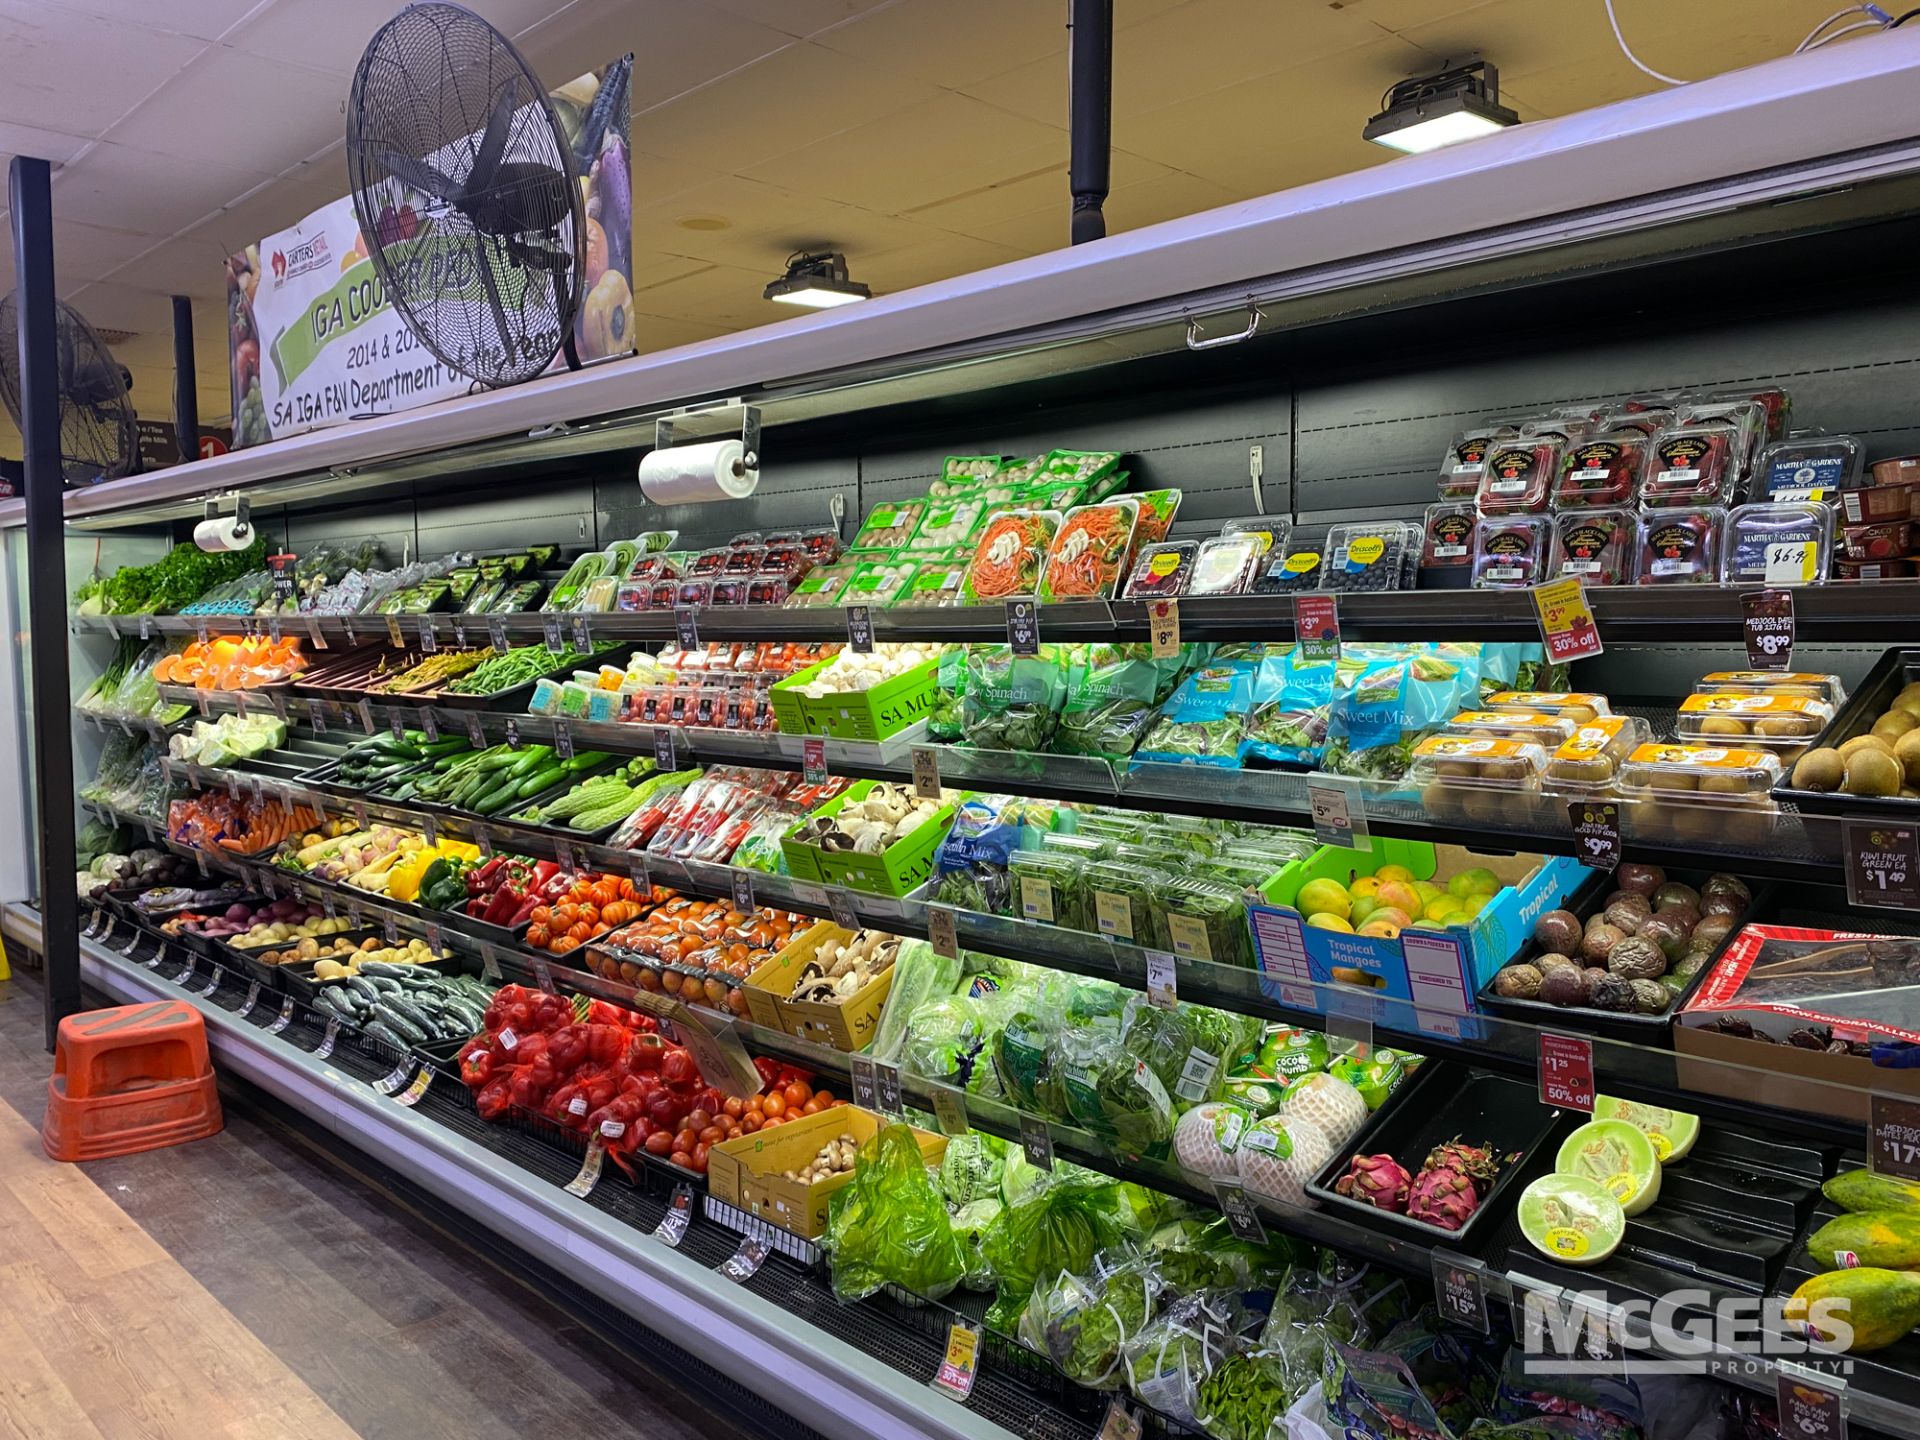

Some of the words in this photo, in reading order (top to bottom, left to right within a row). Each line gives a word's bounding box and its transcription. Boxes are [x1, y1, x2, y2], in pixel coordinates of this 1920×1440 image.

[288, 245, 314, 267] CARTERS
[311, 297, 344, 343] IGA
[347, 339, 378, 370] 2014
[382, 334, 391, 359] &
[272, 402, 293, 428] SA
[297, 393, 324, 423] IGA
[325, 381, 347, 416] F&V
[350, 362, 442, 413] Department
[201, 441, 215, 459] 1
[1811, 458, 1842, 467] GARDENS
[1780, 532, 1811, 542] GARDENS
[1351, 544, 1381, 553] Driscoll's
[1746, 617, 1776, 626] MEDJOOL
[1305, 645, 1324, 655] 30%
[1325, 644, 1338, 655] off
[1554, 637, 1578, 652] 30%
[1580, 632, 1594, 646] off
[986, 687, 1027, 700] Spinach
[1084, 682, 1124, 697] Spinach
[881, 706, 904, 728] SA
[1337, 708, 1379, 724] Sweet
[1383, 709, 1415, 726] Mix
[969, 844, 993, 859] Mix
[1860, 851, 1880, 860] KIWI
[1882, 852, 1907, 862] FRUIT
[1862, 860, 1892, 869] GREEN
[1894, 862, 1907, 871] EA
[900, 865, 921, 889] SA
[1518, 876, 1559, 925] Tropical
[1328, 939, 1375, 956] Tropical
[1331, 951, 1382, 968] Mangoes
[855, 1011, 879, 1034] SA
[1548, 1087, 1573, 1102] 50%
[1575, 1094, 1591, 1106] off
[1884, 1123, 1920, 1137] MEDJOO
